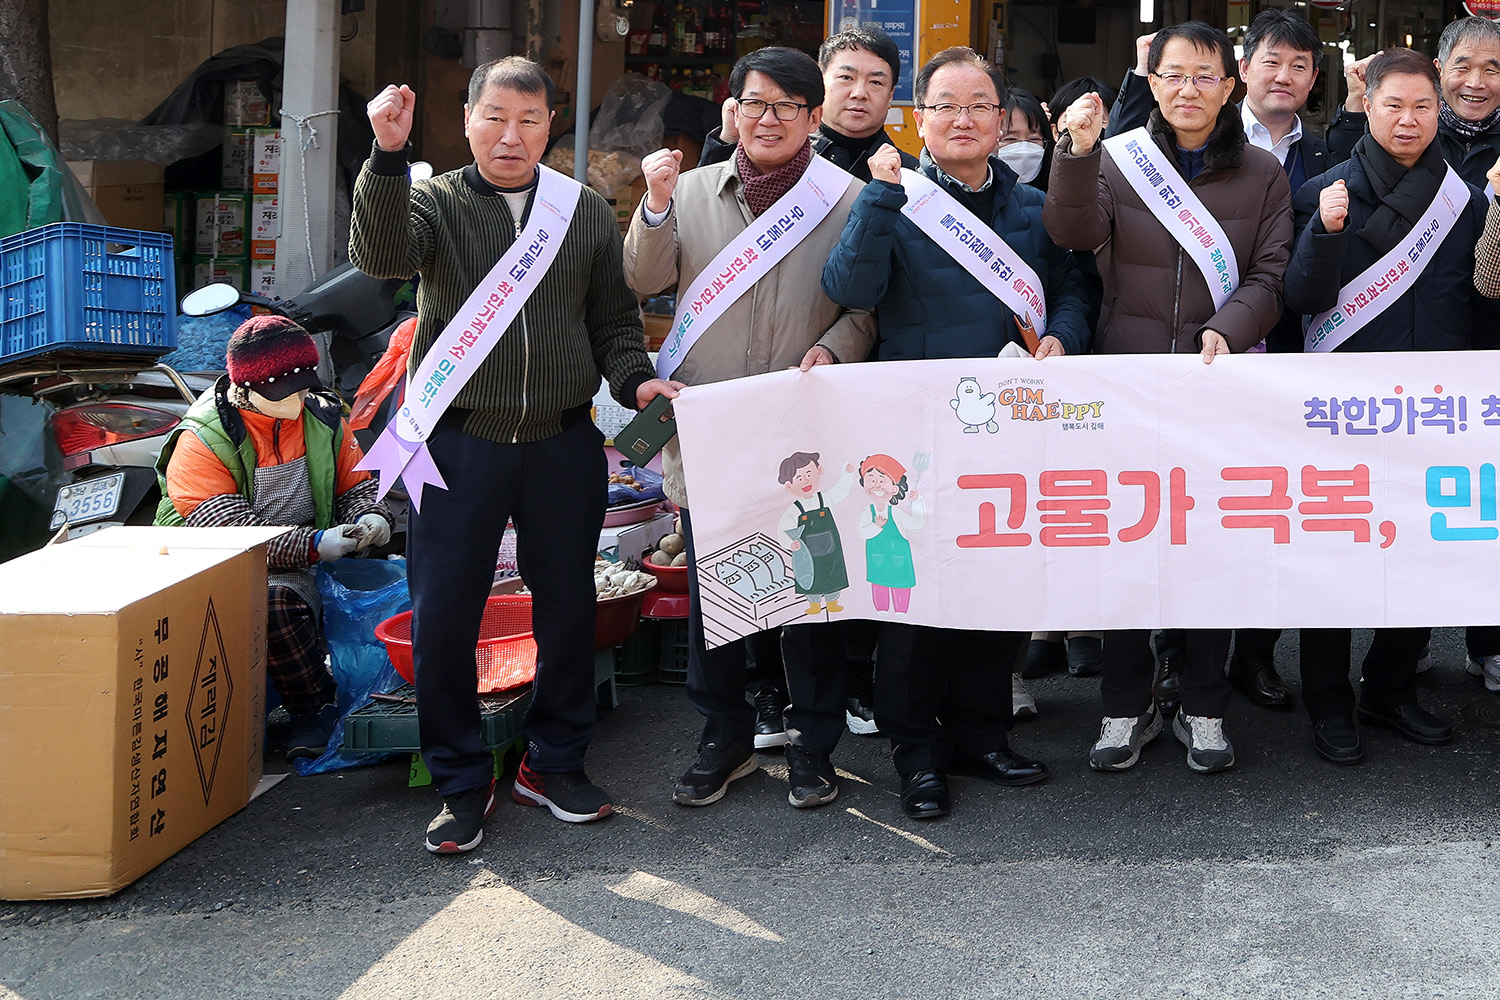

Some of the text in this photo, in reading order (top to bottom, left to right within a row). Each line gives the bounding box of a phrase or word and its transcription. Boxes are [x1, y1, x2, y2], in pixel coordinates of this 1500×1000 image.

[1124, 139, 1165, 189] 물가안정을
[1158, 184, 1183, 211] 위한
[1176, 208, 1216, 250] 슬기로운
[756, 204, 805, 252] 우리동네
[939, 213, 996, 264] 물가안정을
[990, 257, 1015, 282] 위한
[1407, 217, 1440, 264] 우리동네
[689, 245, 760, 316] 착한가격업소
[1343, 259, 1411, 318] 착한가격업소
[417, 228, 550, 409] 우리동네 착한가격업소 이용하기
[999, 386, 1045, 406] GIM
[1062, 422, 1105, 431] 행복도시 김해
[1303, 391, 1468, 436] 착한가격!
[69, 491, 113, 517] 3556
[955, 466, 1196, 549] 고물가
[1217, 463, 1397, 549] 극복,
[149, 616, 169, 838] 무공해자연산
[200, 654, 218, 749] 재래김
